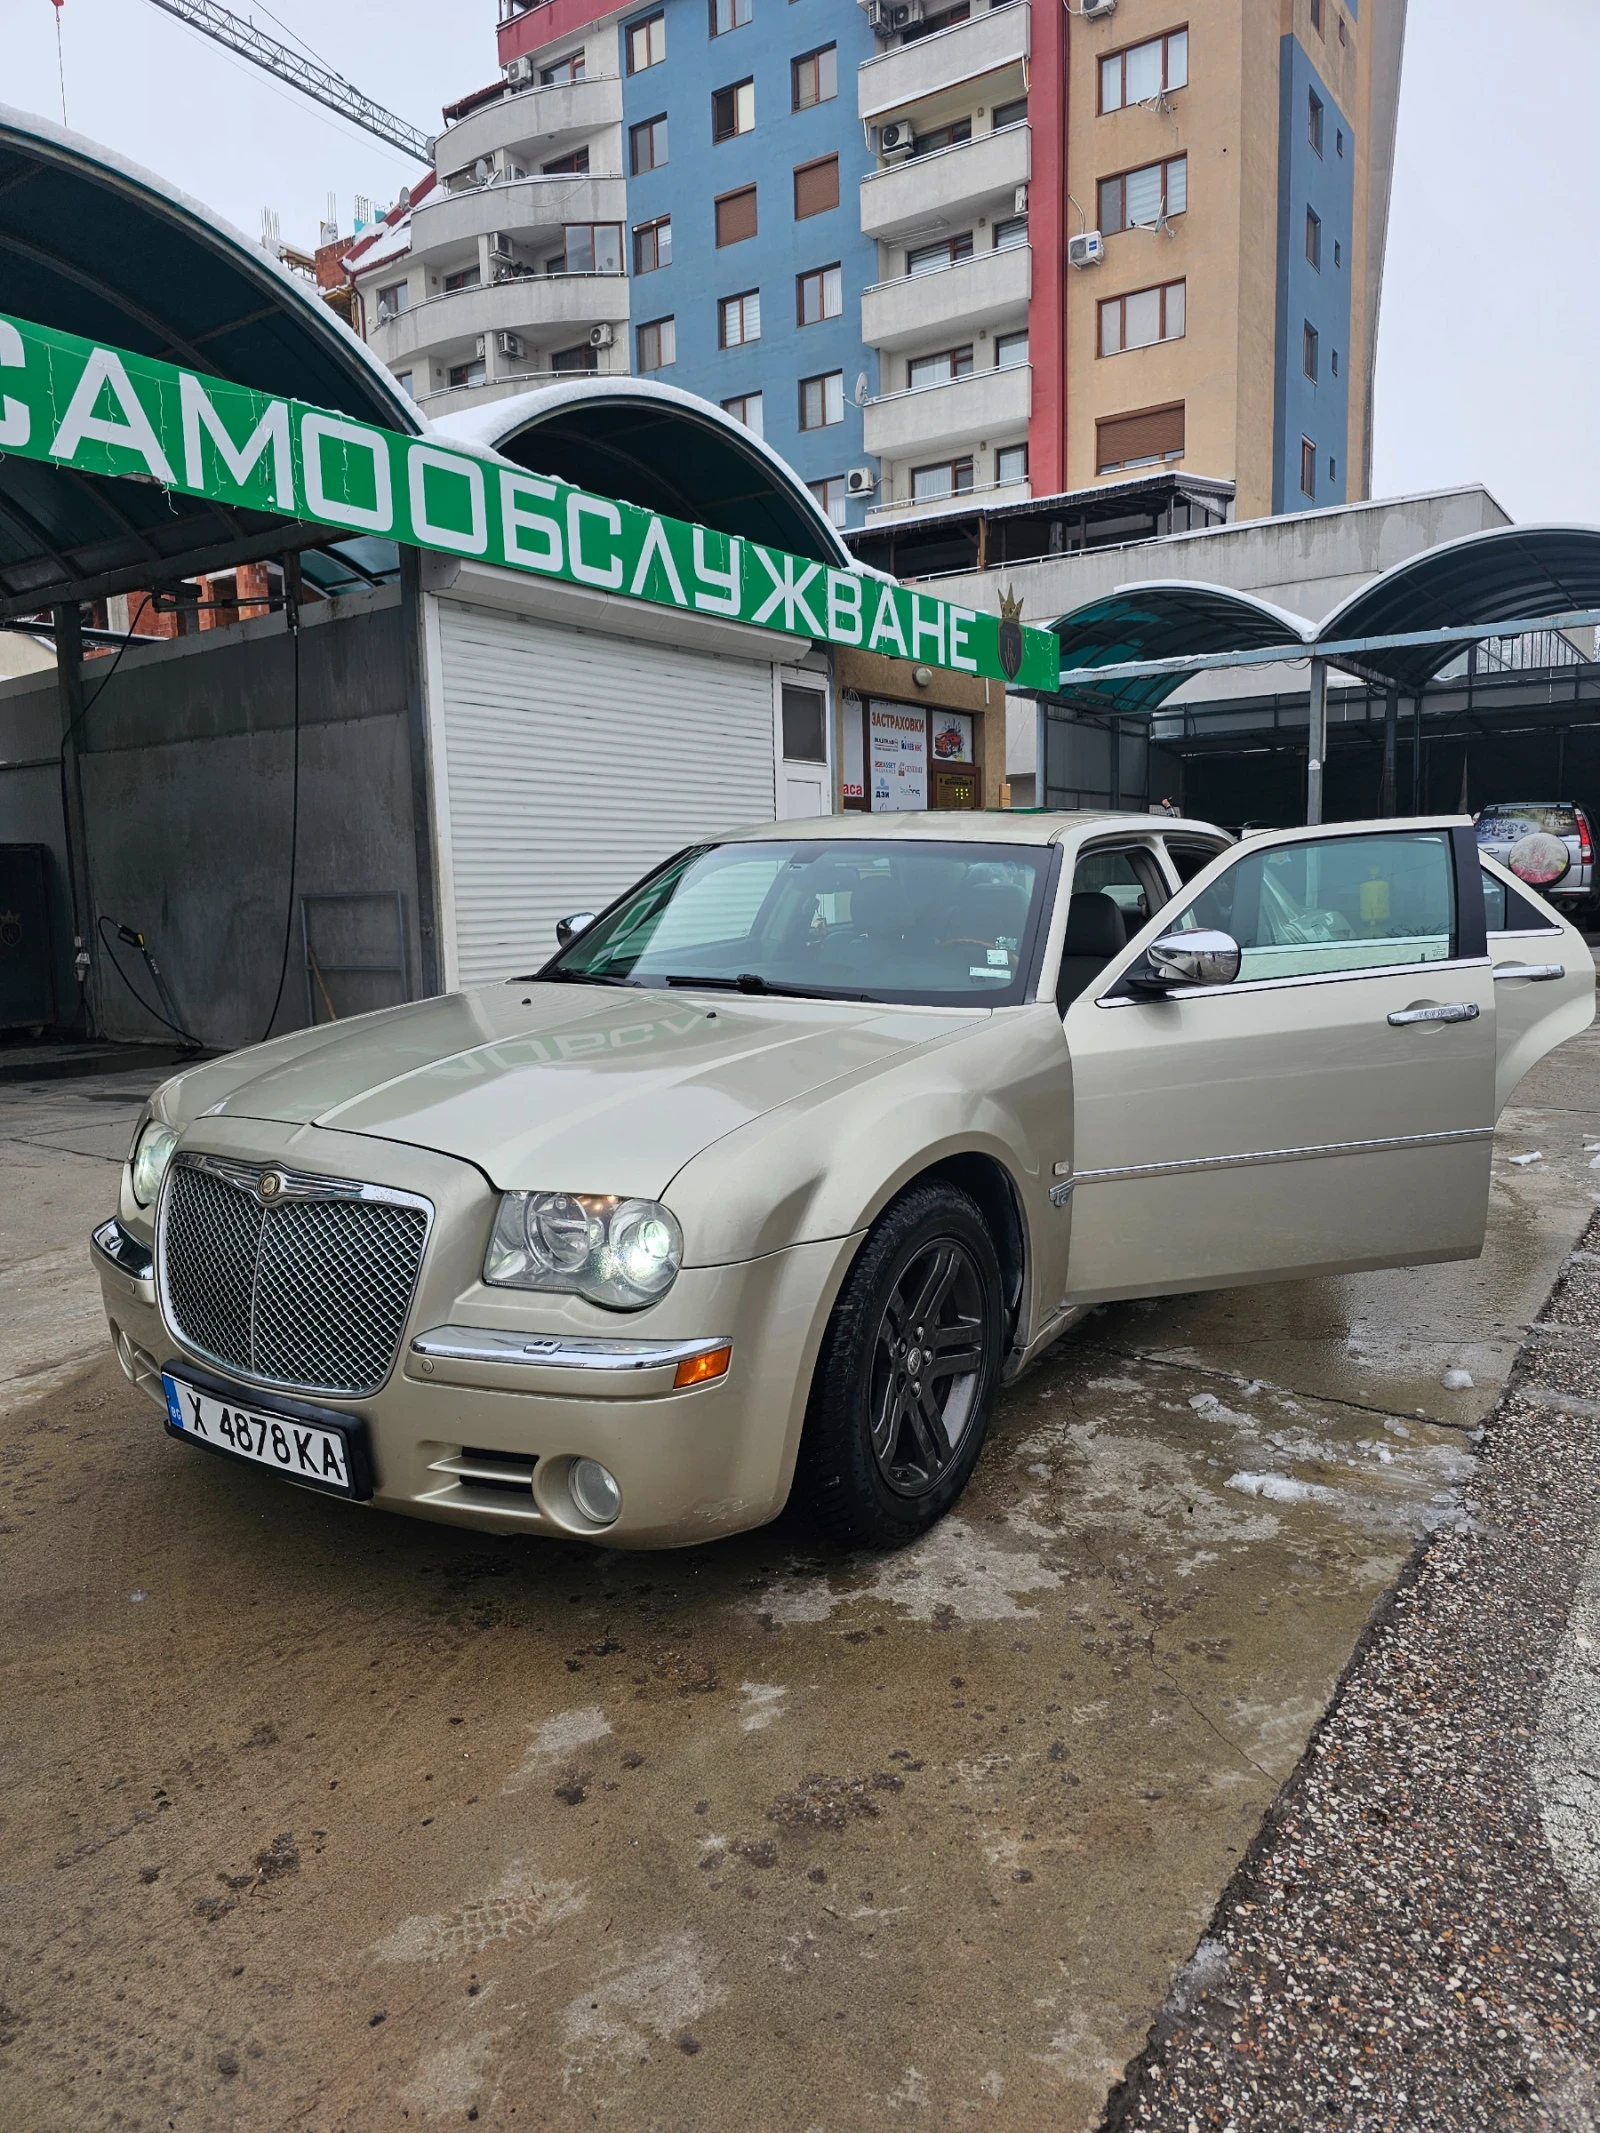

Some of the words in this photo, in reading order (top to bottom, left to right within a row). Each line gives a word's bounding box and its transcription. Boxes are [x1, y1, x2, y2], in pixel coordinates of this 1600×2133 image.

[872, 712, 925, 733] ЗАСТРАХОВКИ
[883, 761, 896, 769] ASSET
[875, 790, 890, 799] ДЗИ
[170, 1407, 182, 1420] BG
[186, 1392, 208, 1436] X
